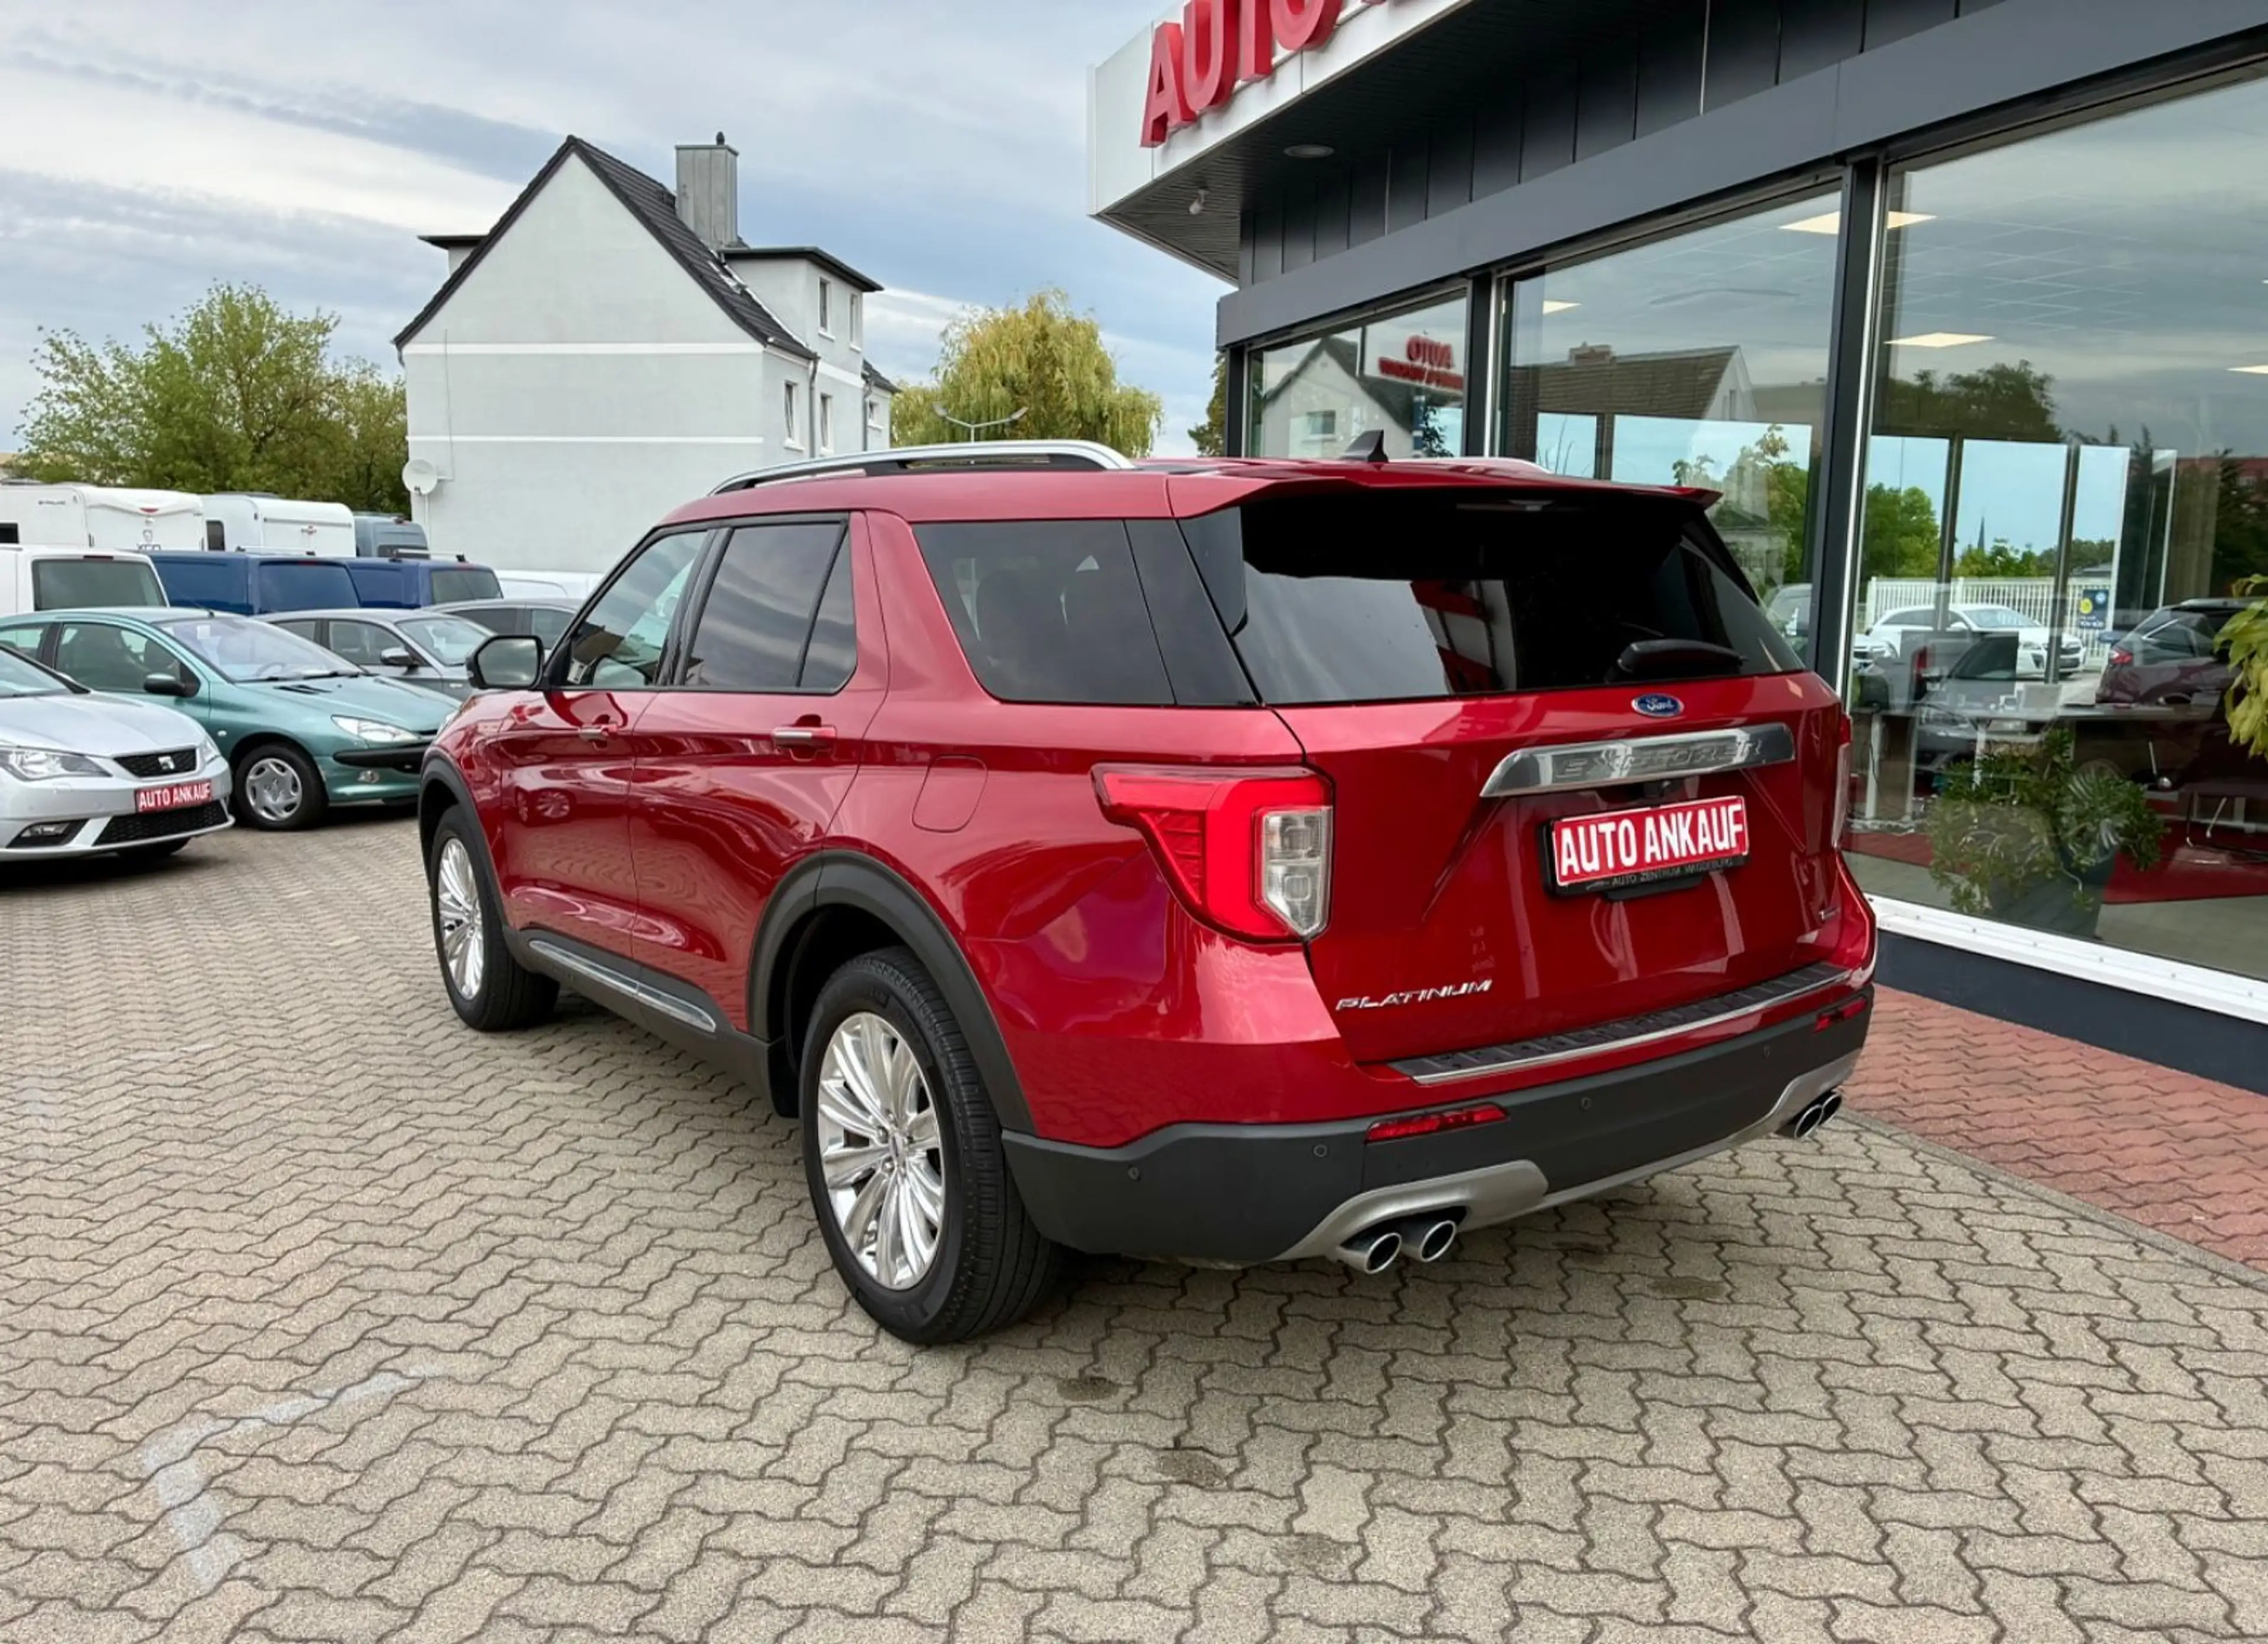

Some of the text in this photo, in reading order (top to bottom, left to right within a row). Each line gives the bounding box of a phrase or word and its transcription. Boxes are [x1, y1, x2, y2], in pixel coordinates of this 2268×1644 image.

[139, 782, 210, 808] AUTO ANKAUF
[1561, 804, 1743, 876] AUTO ANKAUF
[1335, 979, 1493, 1011] PLATINUM
